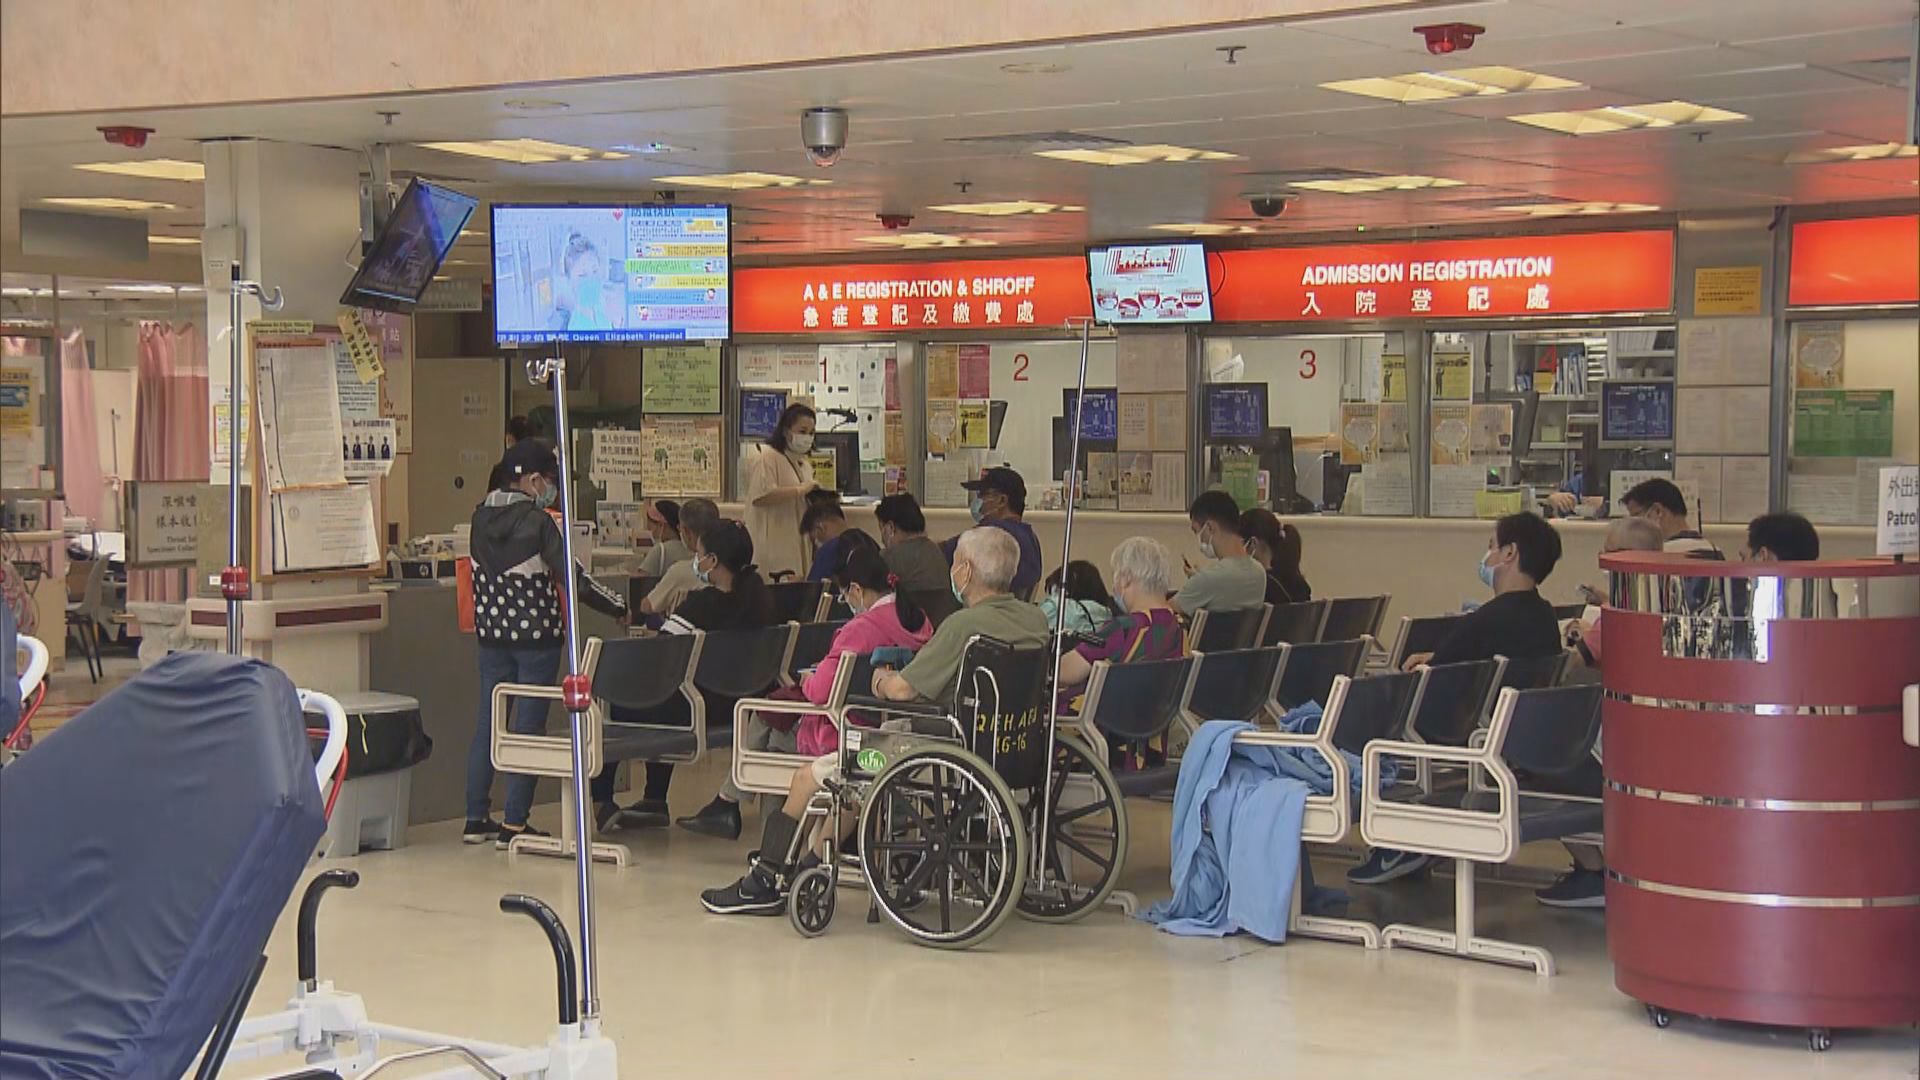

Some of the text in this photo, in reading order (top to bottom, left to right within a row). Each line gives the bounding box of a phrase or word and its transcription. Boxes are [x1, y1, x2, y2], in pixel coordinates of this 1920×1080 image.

[1301, 256, 1552, 285] ADMISSION REGISTRATION
[803, 276, 1035, 301] A & E REGISTRATION & SHROFF
[1301, 283, 1550, 315] 入院登記處
[803, 300, 1035, 328] 急症登記及繳費處
[573, 334, 600, 342] Queen
[605, 332, 644, 342] Elizabeth
[650, 331, 683, 341] Hospital
[819, 356, 827, 384] 1
[1014, 353, 1029, 381] 2
[1300, 350, 1317, 379] 3
[1538, 344, 1557, 376] 4
